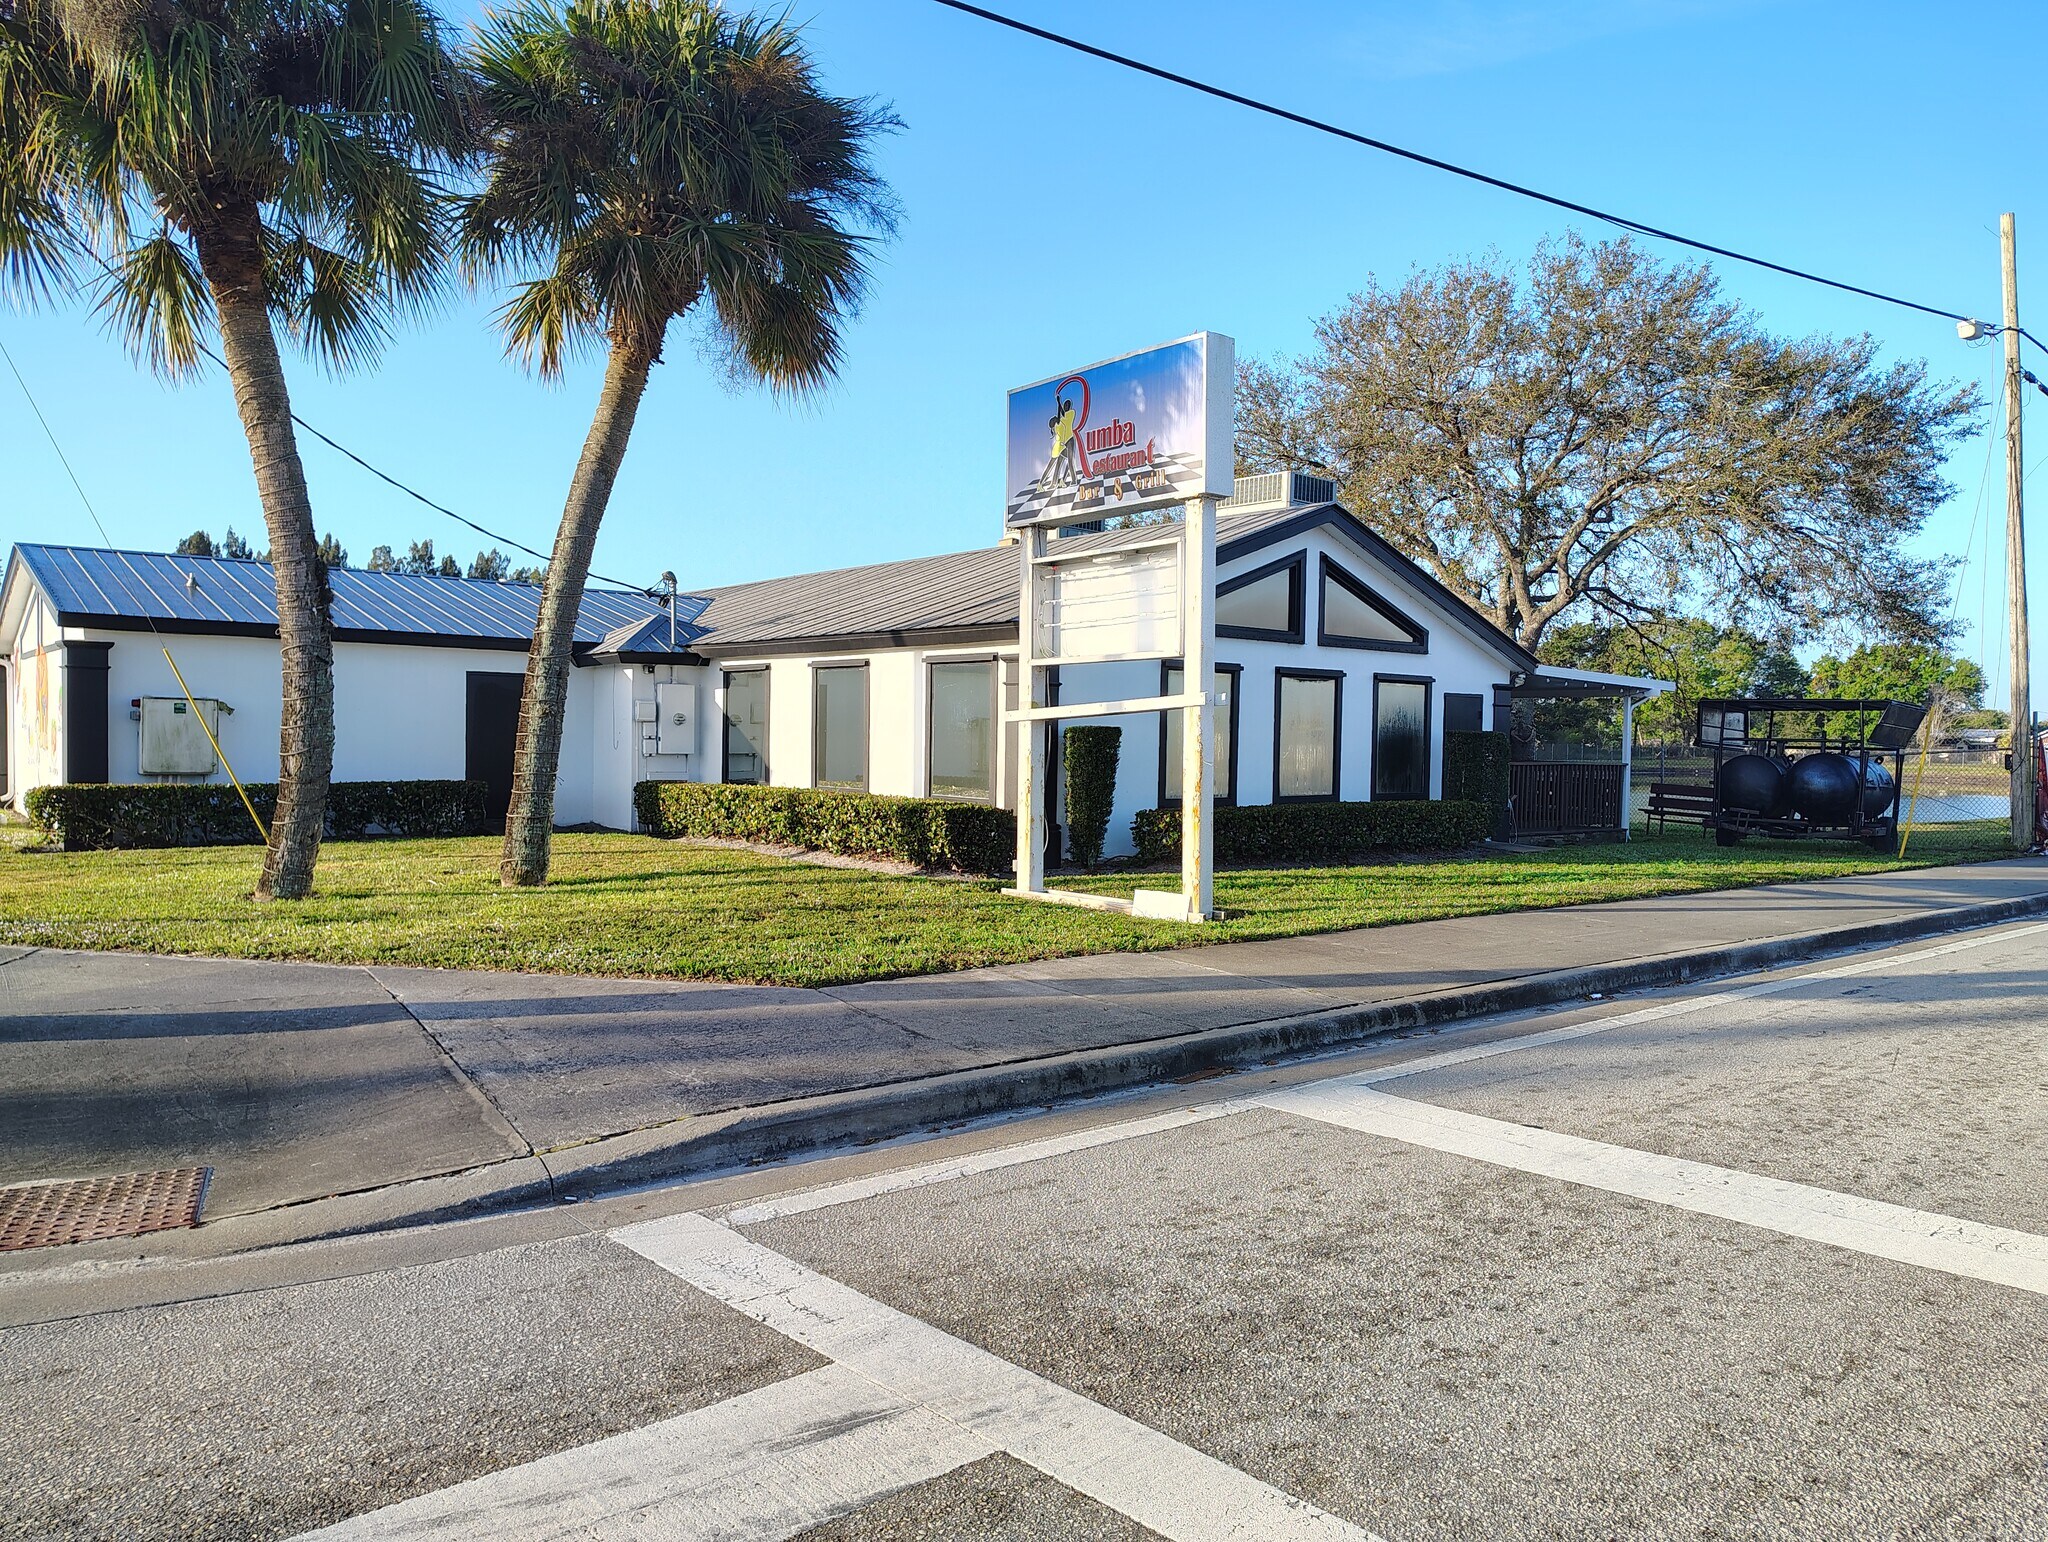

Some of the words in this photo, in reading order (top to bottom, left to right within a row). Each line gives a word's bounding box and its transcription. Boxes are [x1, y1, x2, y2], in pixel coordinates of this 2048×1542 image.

[1055, 376, 1136, 480] Rumba
[1079, 485, 1100, 501] Bar
[1113, 478, 1123, 501] &
[1135, 469, 1167, 490] Grill
